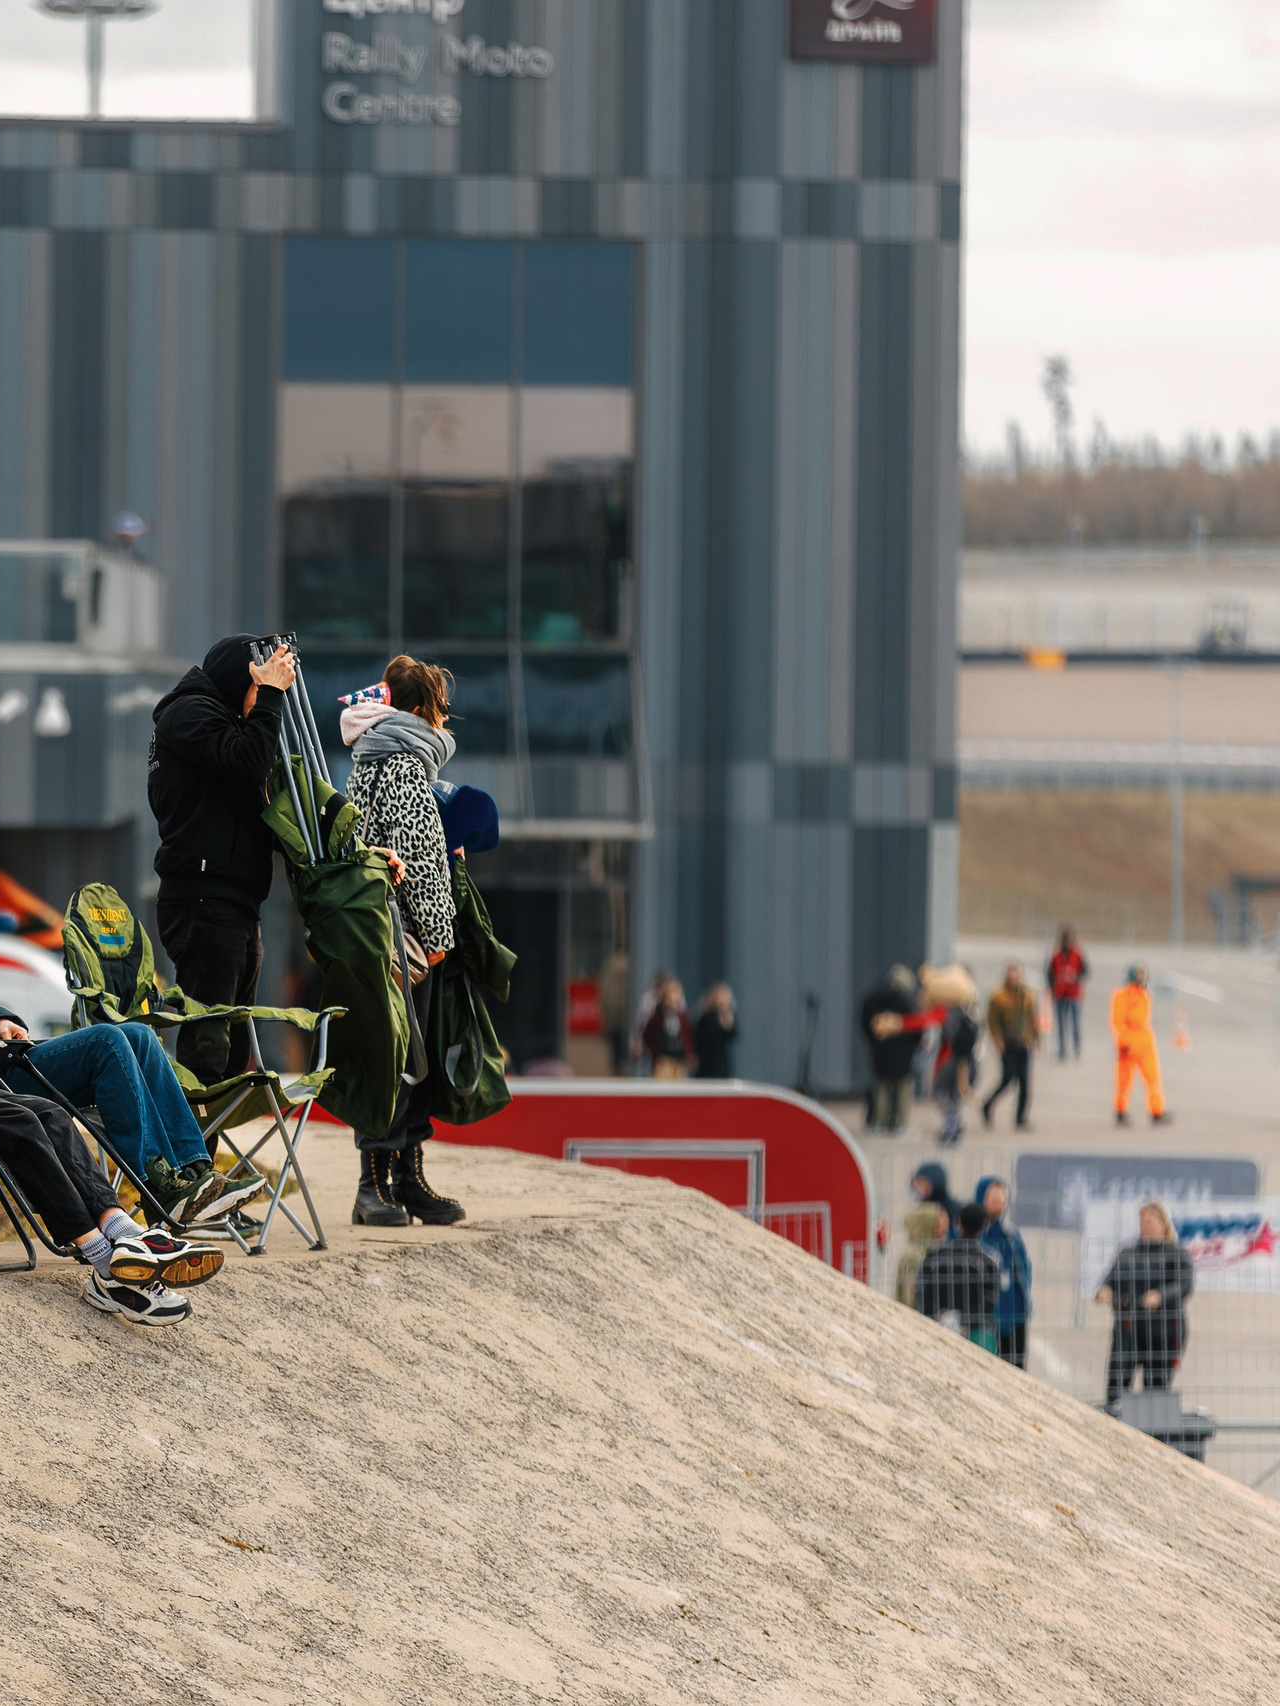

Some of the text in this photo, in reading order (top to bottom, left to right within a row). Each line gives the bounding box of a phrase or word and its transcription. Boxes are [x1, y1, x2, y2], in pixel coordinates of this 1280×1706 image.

[322, 31, 554, 84] Rally Moto
[322, 81, 462, 126] Centre
